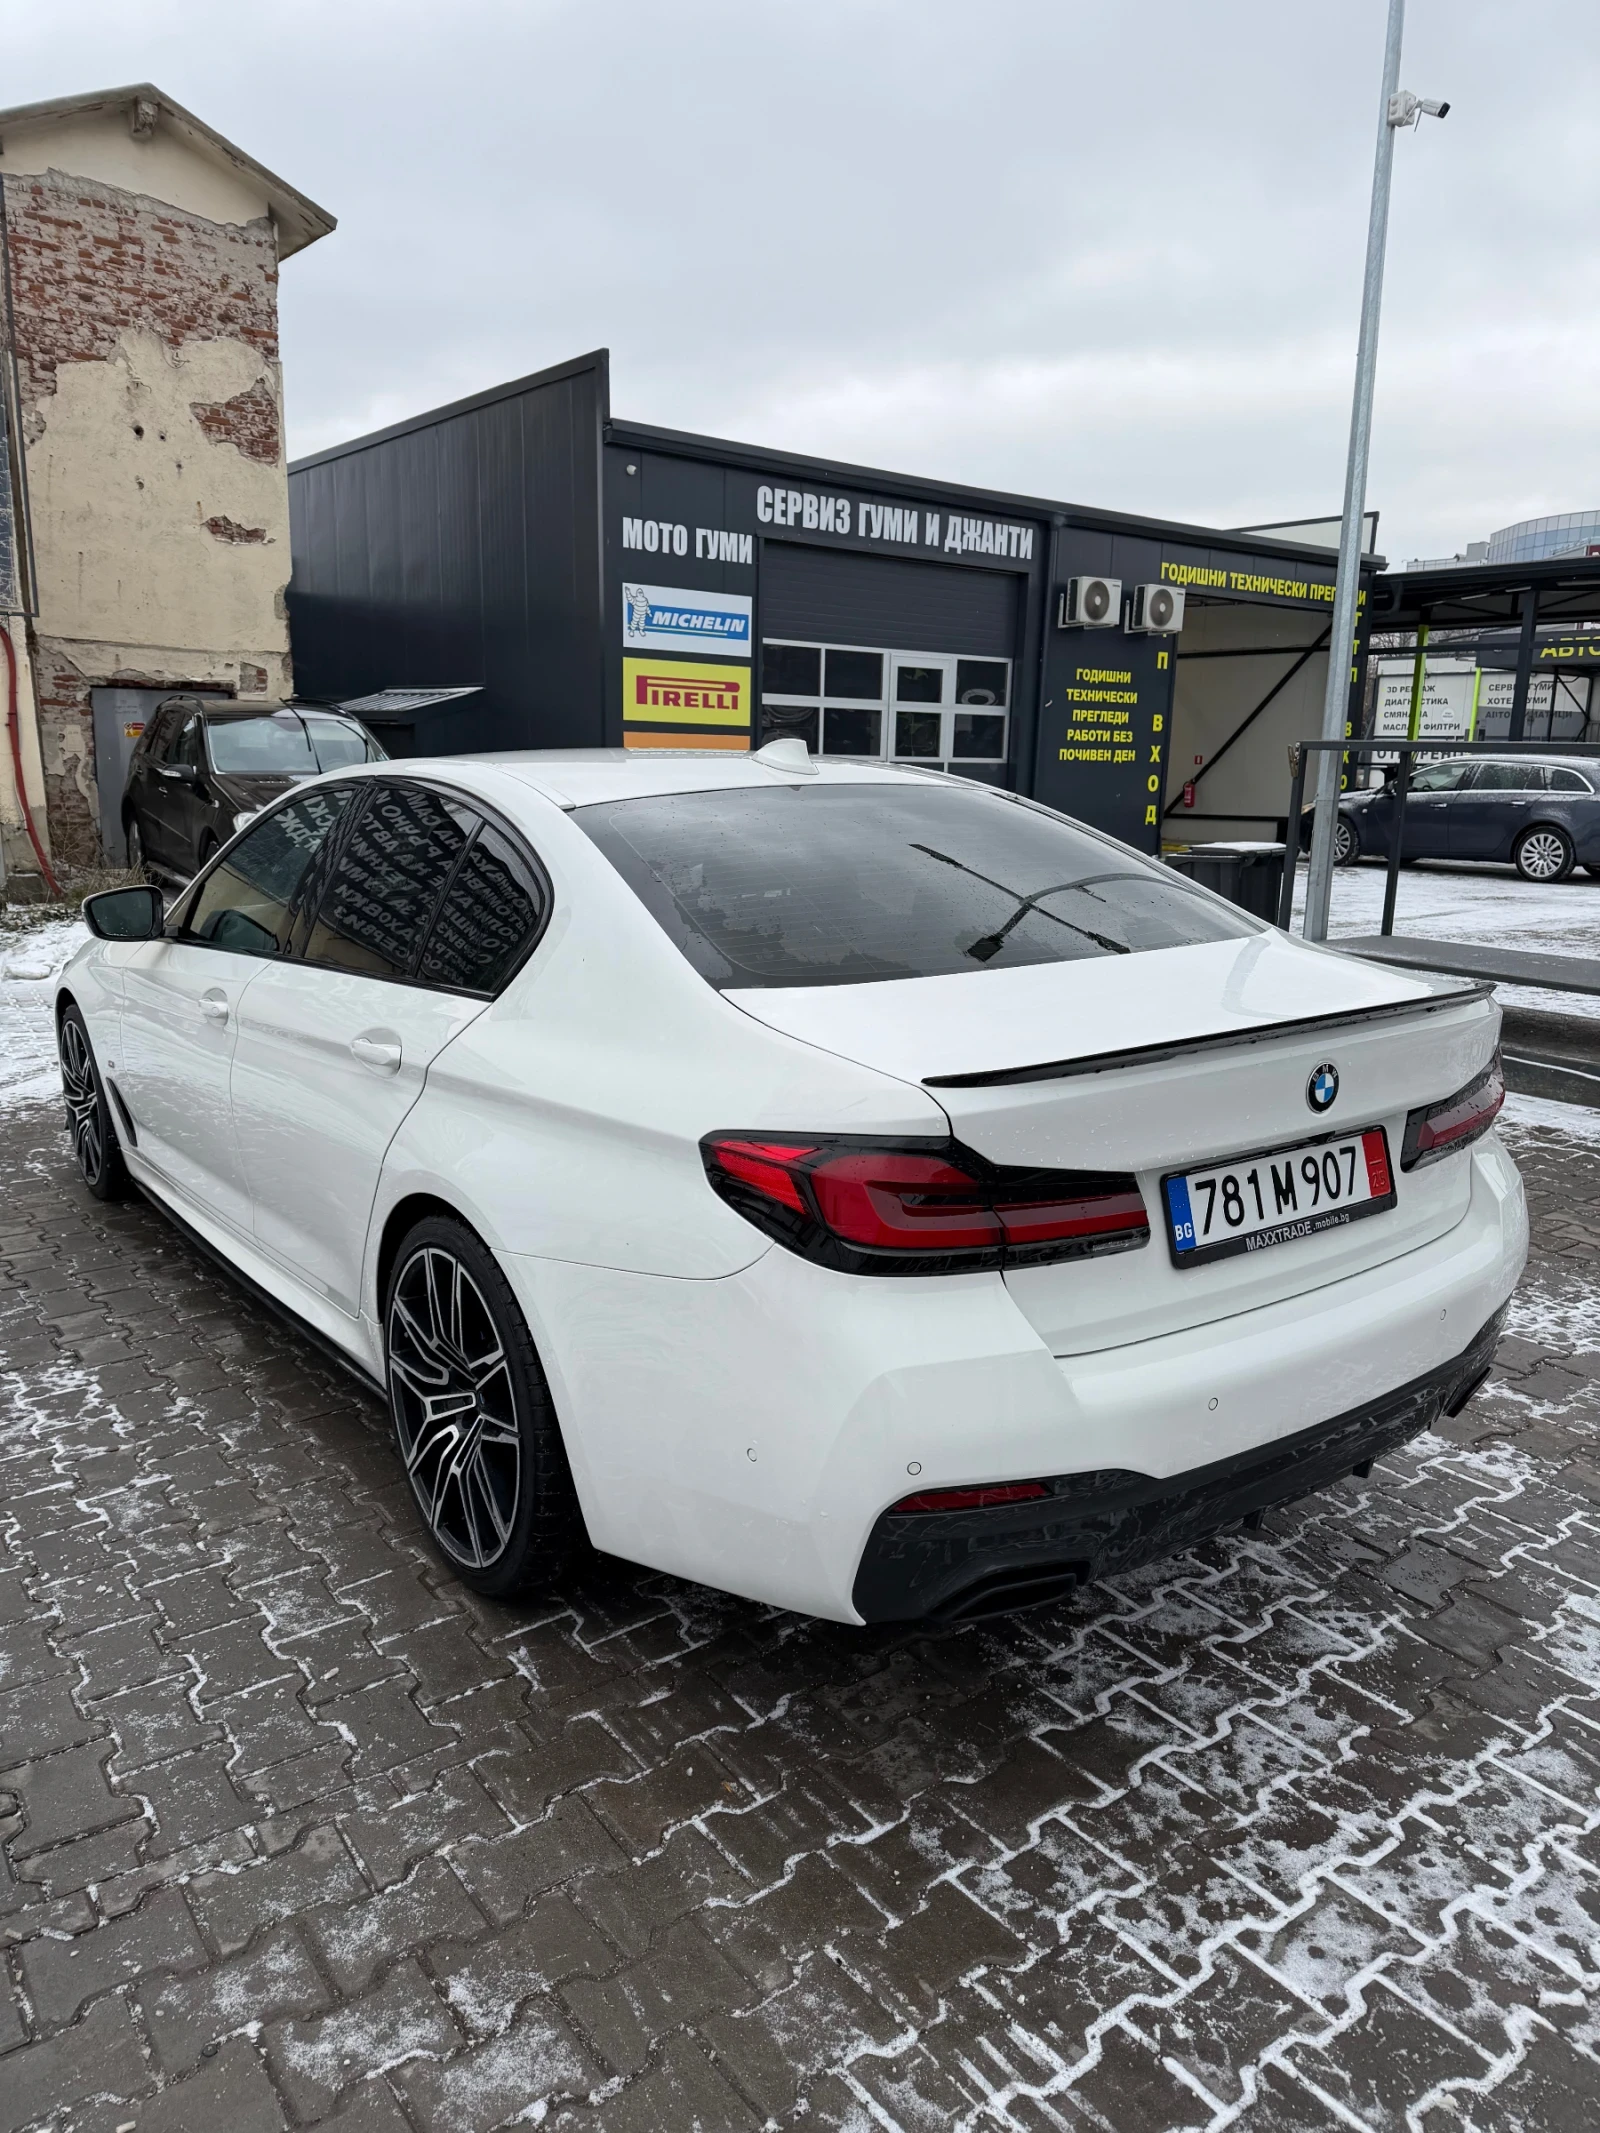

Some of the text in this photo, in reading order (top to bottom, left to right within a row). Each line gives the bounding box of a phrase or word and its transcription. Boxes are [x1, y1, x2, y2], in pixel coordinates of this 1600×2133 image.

[756, 485, 1034, 560] СЕРВИЗ ГУМИ И ДЖАНТИ
[622, 516, 753, 564] МОТО ГУМИ
[1160, 561, 1227, 586] ГОДИШНИ
[1229, 571, 1307, 599] ТЕХНИЧЕСКИ
[652, 609, 746, 633] MICHELIN
[1076, 668, 1132, 684] ГОДИШНИ
[636, 674, 741, 711] PIRELLI
[1066, 688, 1138, 704] ТЕХНИЧЕСКИ
[1072, 709, 1129, 725] ПРЕГЛЕДИ
[1423, 723, 1461, 731] ФИЛТРИ
[1066, 729, 1133, 743] РАБОТИ БЕЗ
[1059, 748, 1136, 763] ПОЧИВЕН ДЕН
[1145, 714, 1164, 825] ВХОД
[1174, 1222, 1193, 1242] BG
